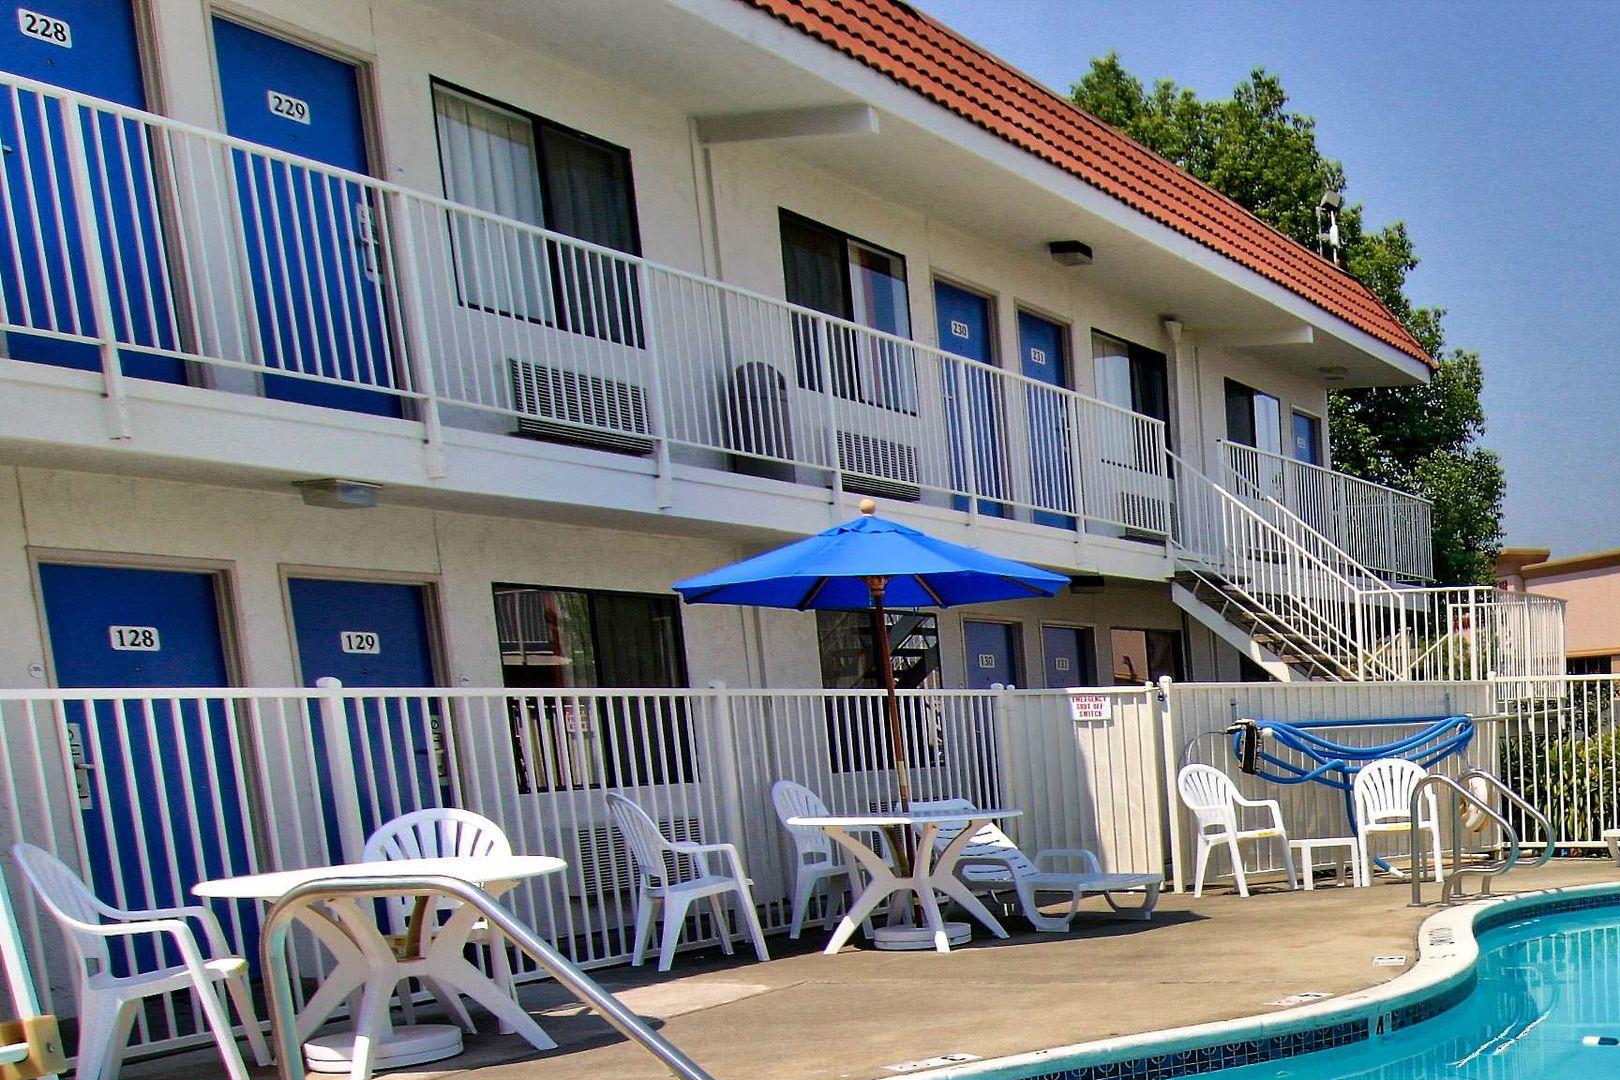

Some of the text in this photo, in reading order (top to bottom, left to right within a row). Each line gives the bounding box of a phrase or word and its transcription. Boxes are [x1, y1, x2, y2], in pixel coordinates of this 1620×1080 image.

[24, 13, 67, 42] 228
[272, 95, 306, 119] 229
[115, 630, 155, 647] 128
[345, 634, 376, 651] 129
